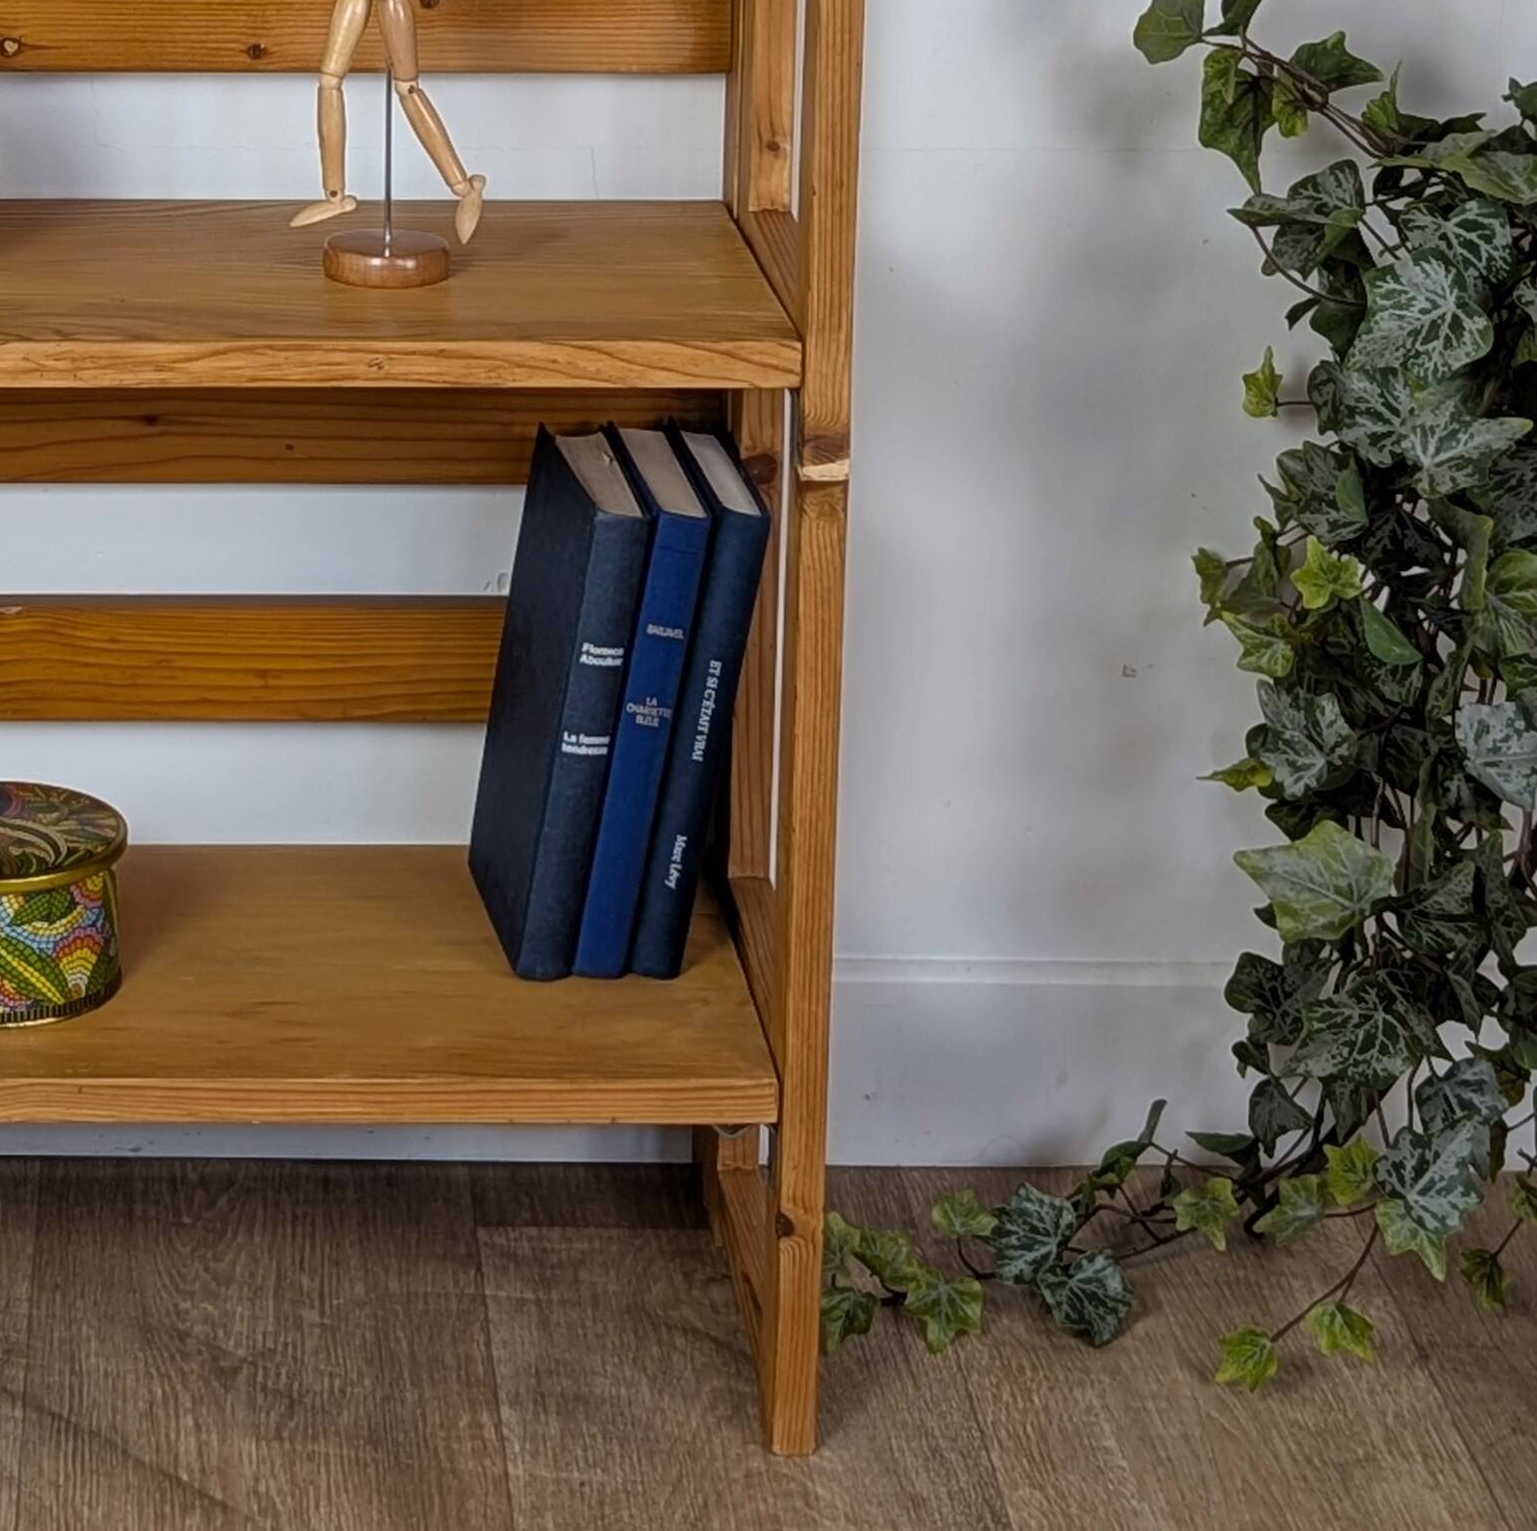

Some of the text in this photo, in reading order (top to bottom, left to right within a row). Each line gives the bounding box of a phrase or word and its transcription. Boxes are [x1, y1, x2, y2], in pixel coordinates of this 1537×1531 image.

[709, 659, 722, 676] ET
[706, 676, 719, 689] SI
[646, 696, 658, 707] LA
[563, 731, 578, 744] La
[691, 734, 707, 762] VRAI
